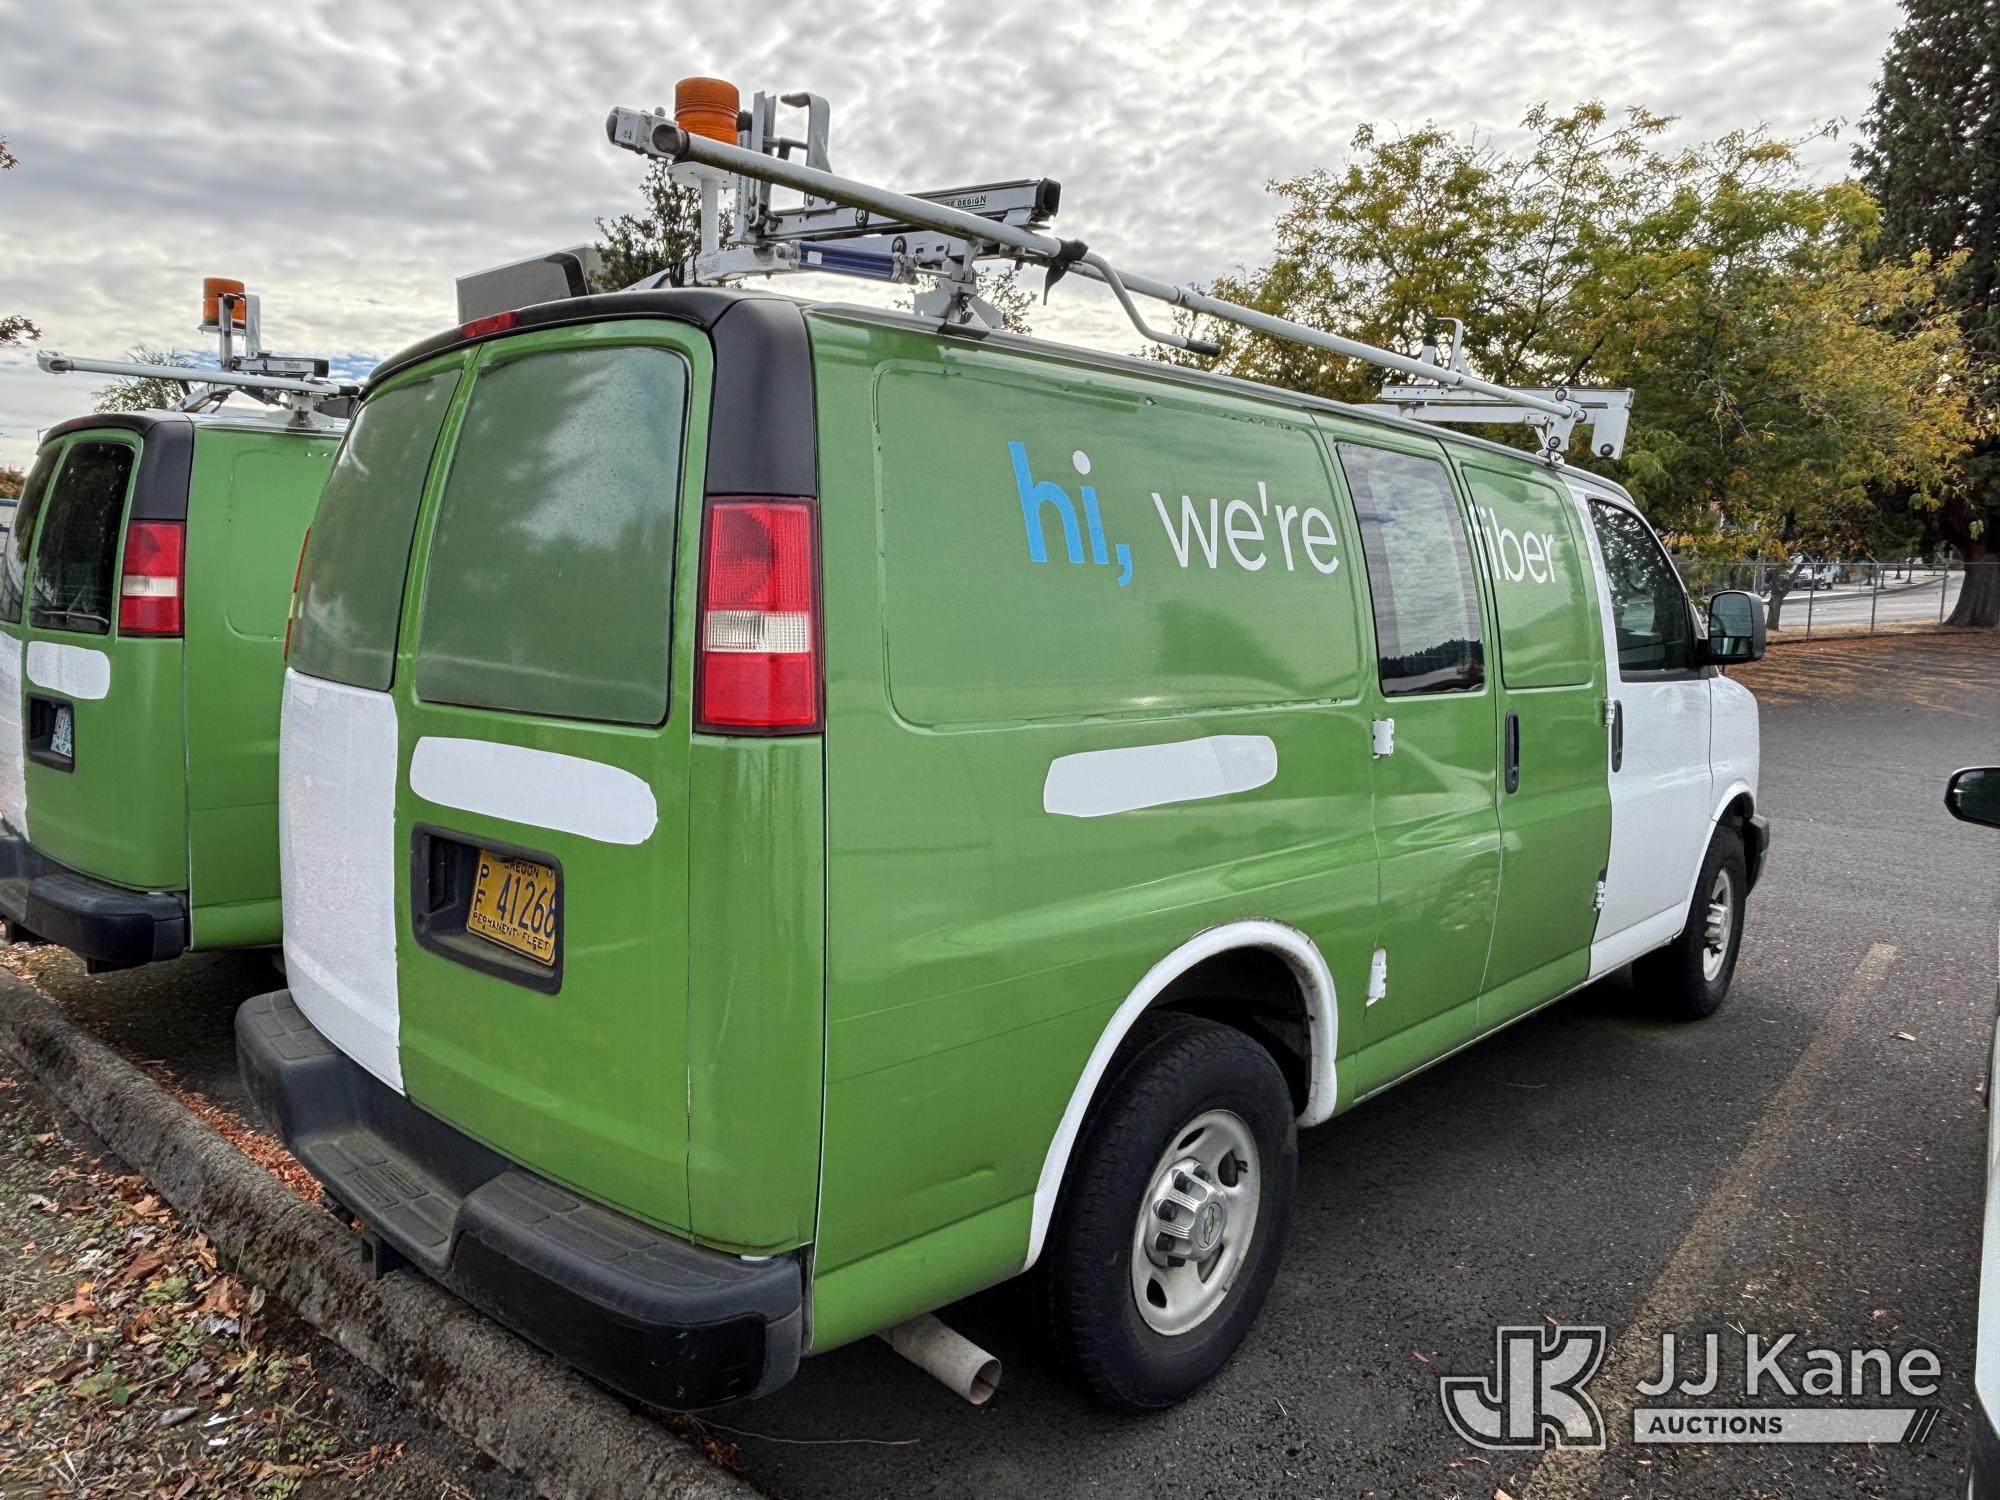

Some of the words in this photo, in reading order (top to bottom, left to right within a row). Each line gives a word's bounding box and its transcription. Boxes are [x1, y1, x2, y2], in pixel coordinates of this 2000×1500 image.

[1008, 441, 1133, 586] hi,
[1151, 481, 1340, 574] we're
[473, 911, 518, 937] PERMANENT
[522, 932, 550, 951] FLEET
